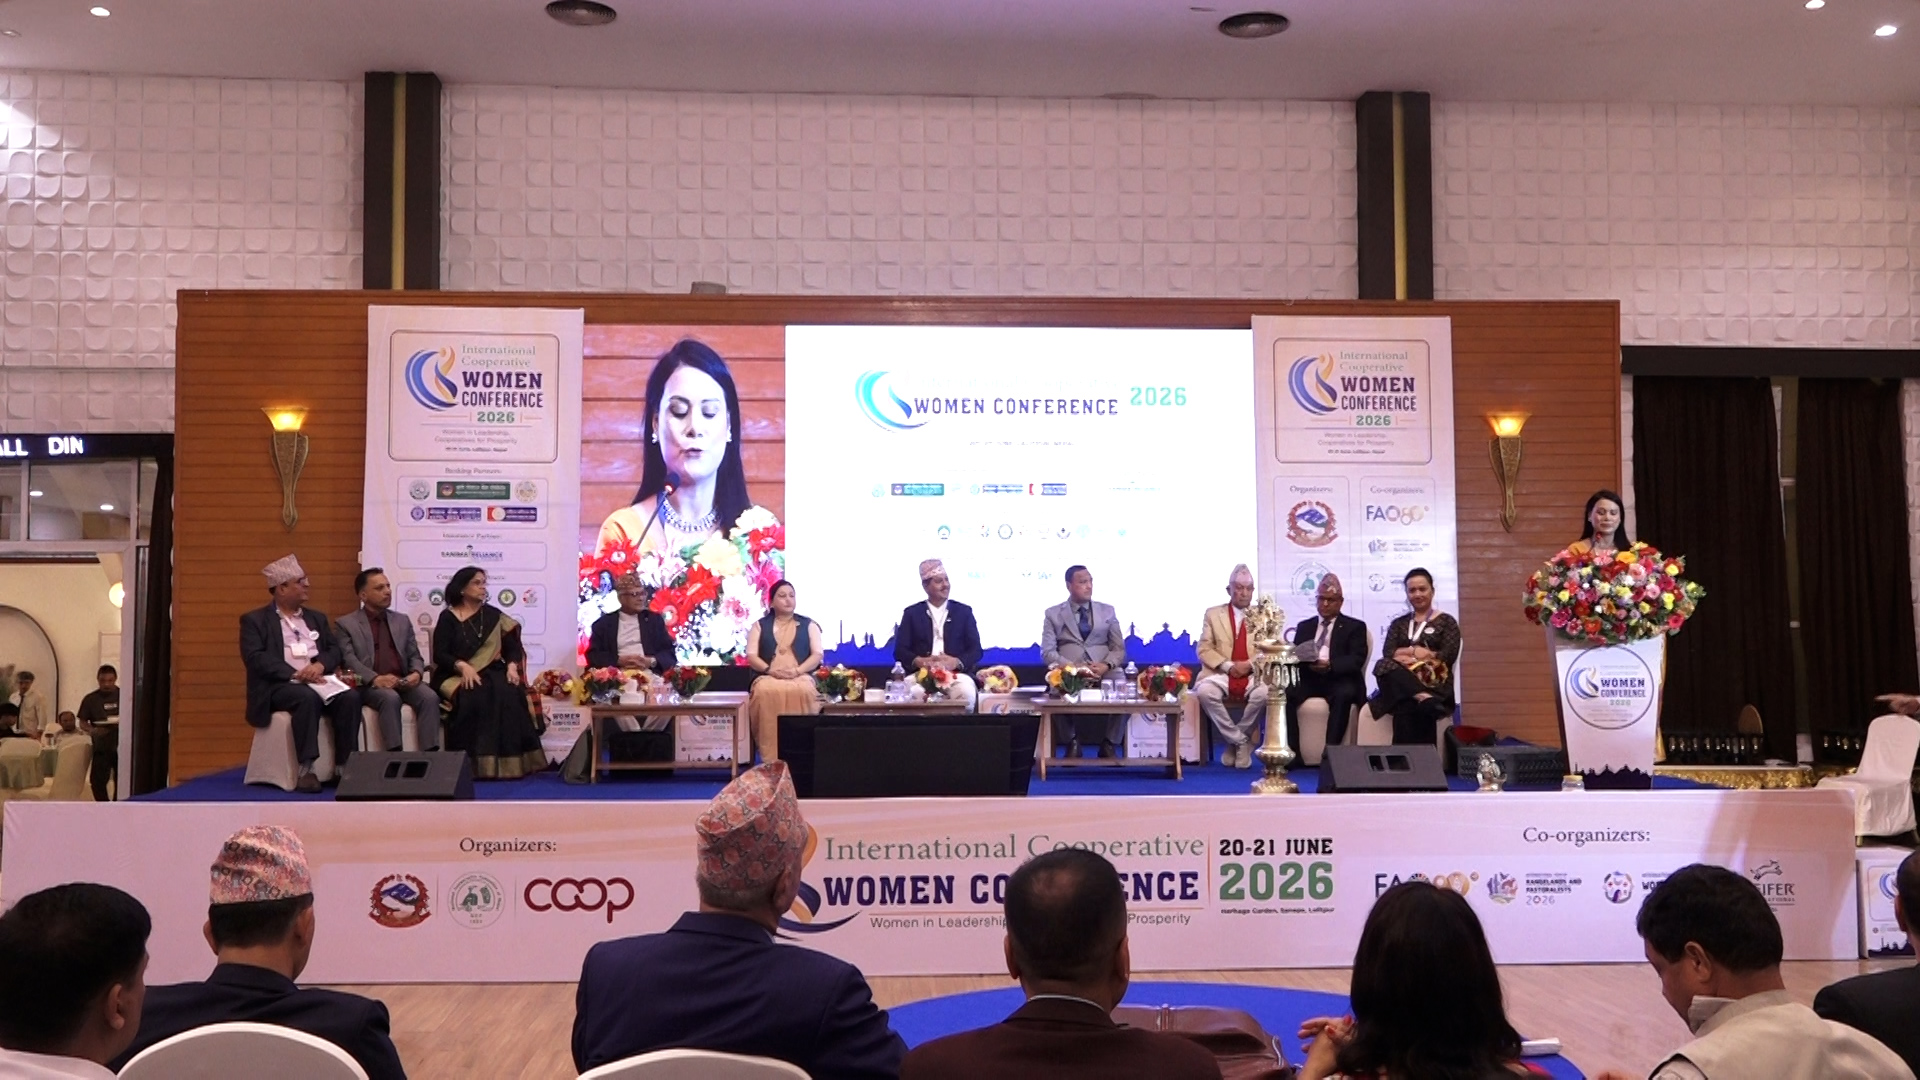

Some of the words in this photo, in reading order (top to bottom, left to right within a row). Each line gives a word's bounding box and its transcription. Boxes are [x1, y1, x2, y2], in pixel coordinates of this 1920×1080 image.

[462, 345, 536, 356] International
[1340, 351, 1408, 360] International
[461, 356, 531, 368] Cooperative
[1340, 362, 1404, 373] Cooperative
[462, 371, 543, 389] WOMEN
[1340, 376, 1415, 393] WOMEN
[462, 391, 544, 408] CONFERENCE
[1130, 386, 1187, 406] 2026
[1341, 395, 1417, 411] CONFERENCE
[914, 397, 985, 414] WOMEN
[994, 397, 1119, 415] CONFERENCE
[477, 411, 515, 423] 2026
[1356, 415, 1391, 426] 2026
[48, 435, 84, 455] DIN
[1600, 677, 1645, 688] WOMEN
[1523, 826, 1651, 848] Co-organizers:
[459, 837, 557, 857] Organizers:
[825, 834, 1016, 860] International
[1219, 838, 1275, 856] 20-21
[1285, 838, 1333, 855] JUNE
[1219, 861, 1334, 900] 2026
[823, 875, 955, 906] WOMEN
[1526, 895, 1555, 906] 2026
[870, 917, 919, 929] Women
[923, 916, 934, 928] in
[1128, 912, 1191, 926] Prosperity
